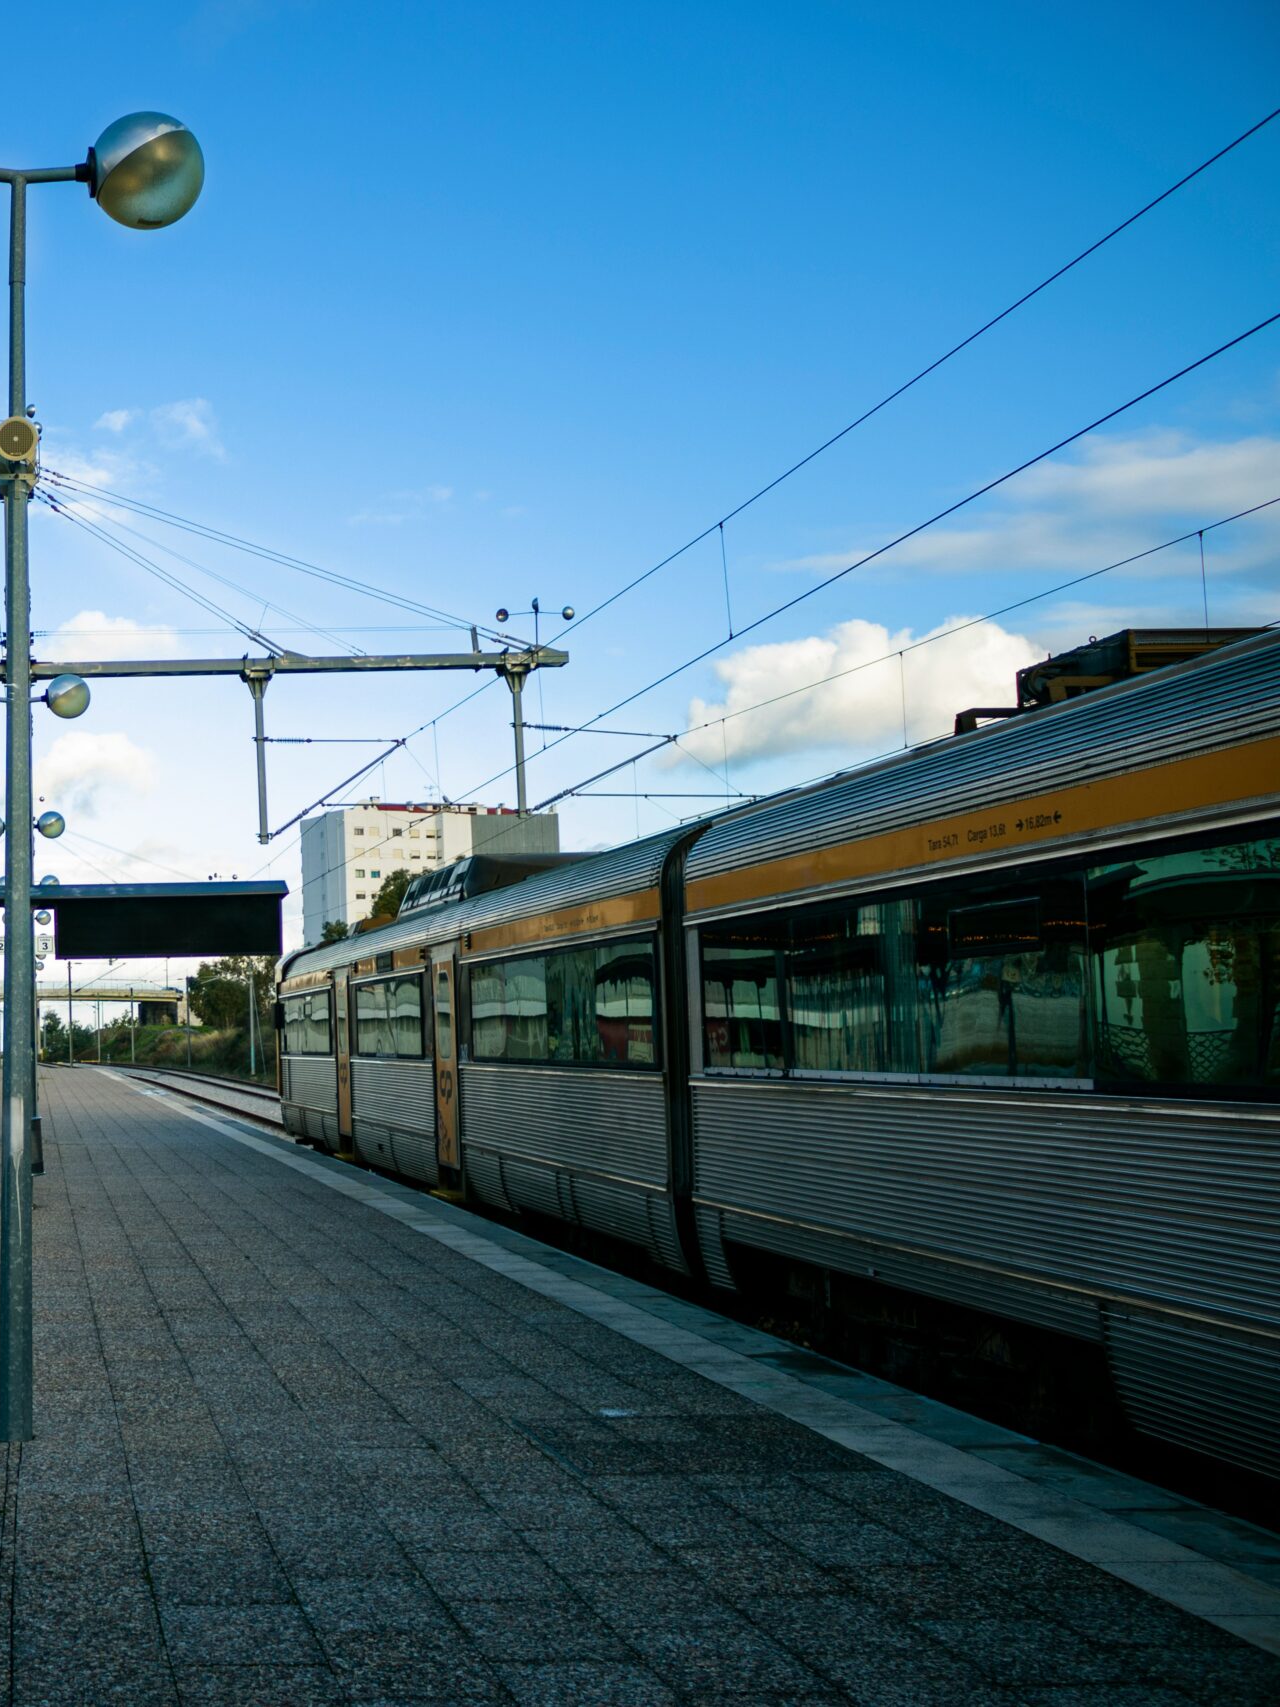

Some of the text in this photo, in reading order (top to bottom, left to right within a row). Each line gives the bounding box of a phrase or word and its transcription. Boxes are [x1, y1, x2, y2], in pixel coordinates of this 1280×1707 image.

[927, 839, 942, 851] Tara
[967, 829, 988, 843] Carga
[42, 942, 49, 951] 3
